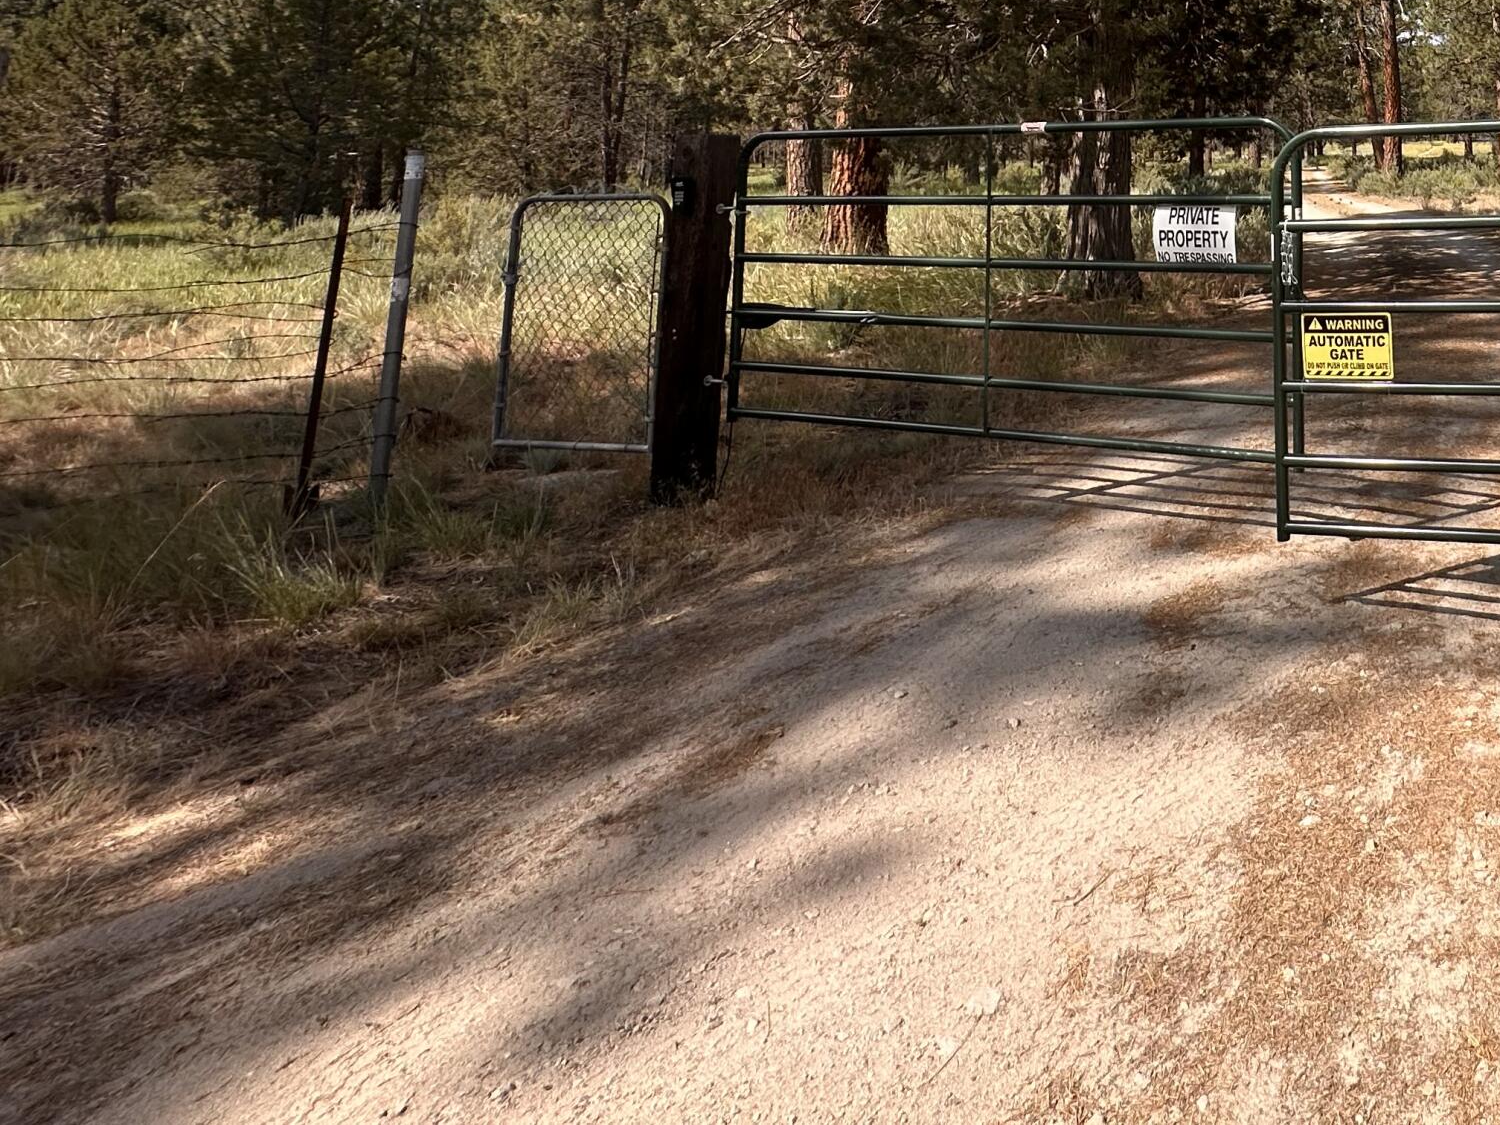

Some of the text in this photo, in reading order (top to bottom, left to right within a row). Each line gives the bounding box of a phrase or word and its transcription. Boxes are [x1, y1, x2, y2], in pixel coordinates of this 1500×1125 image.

[1168, 207, 1220, 225] PRIVATE
[1158, 230, 1229, 248] PROPERTY
[1157, 251, 1234, 264] NO TRESPASSING
[1325, 319, 1384, 331] WARNING
[1308, 335, 1386, 347] AUTOMATIC
[1330, 349, 1364, 360] GATE
